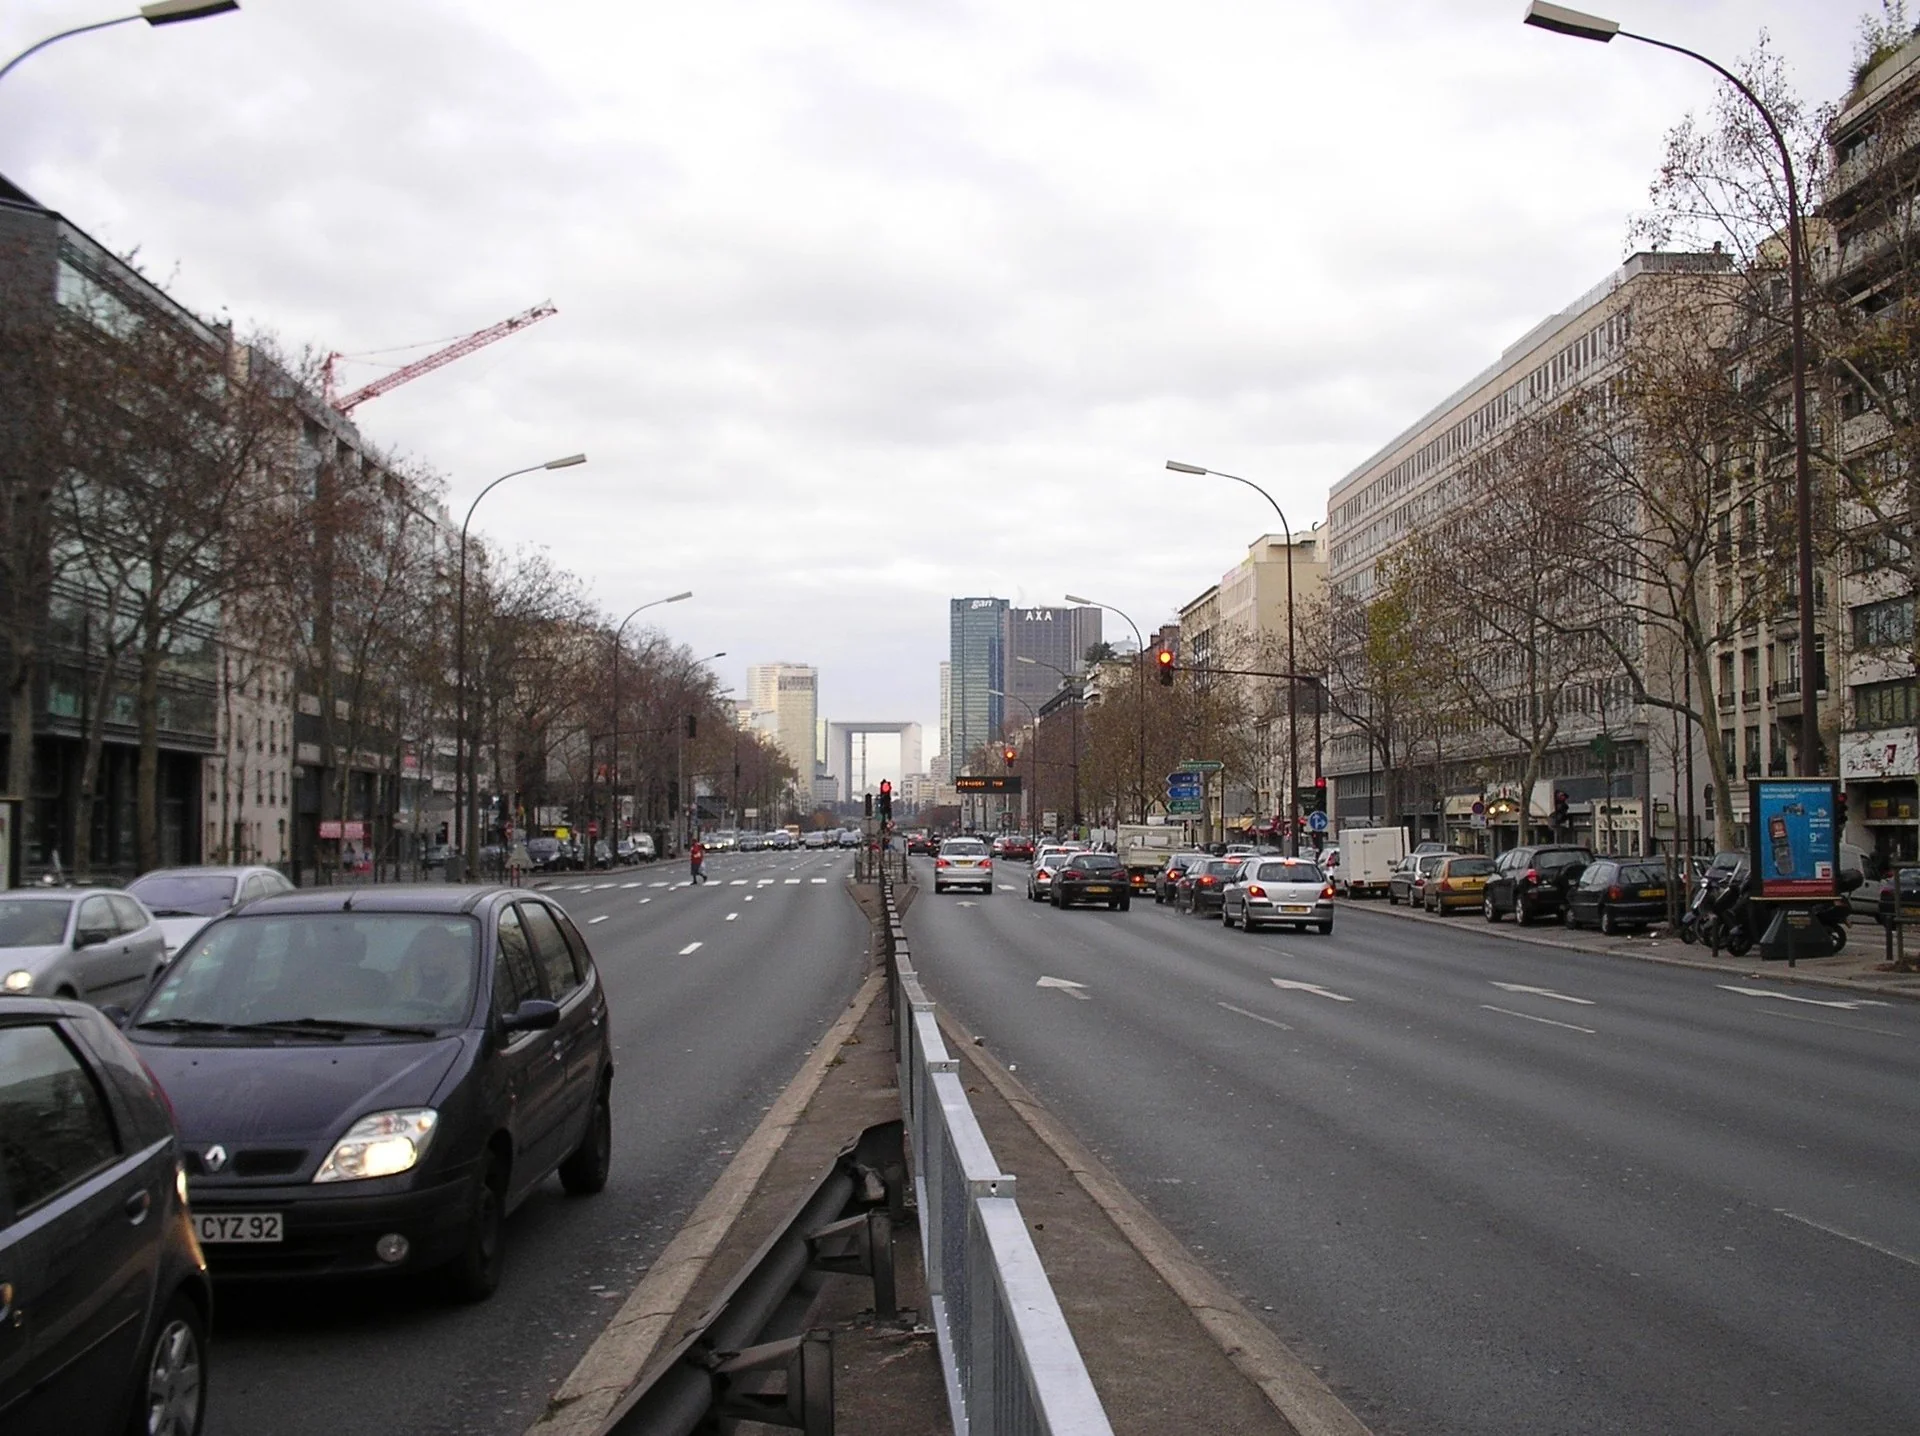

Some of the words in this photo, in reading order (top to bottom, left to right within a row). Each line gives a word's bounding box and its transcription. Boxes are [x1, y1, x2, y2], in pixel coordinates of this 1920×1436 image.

[971, 600, 993, 609] gan
[1025, 610, 1052, 621] AXA
[202, 1216, 244, 1239] CYZ
[250, 1216, 278, 1239] 92
